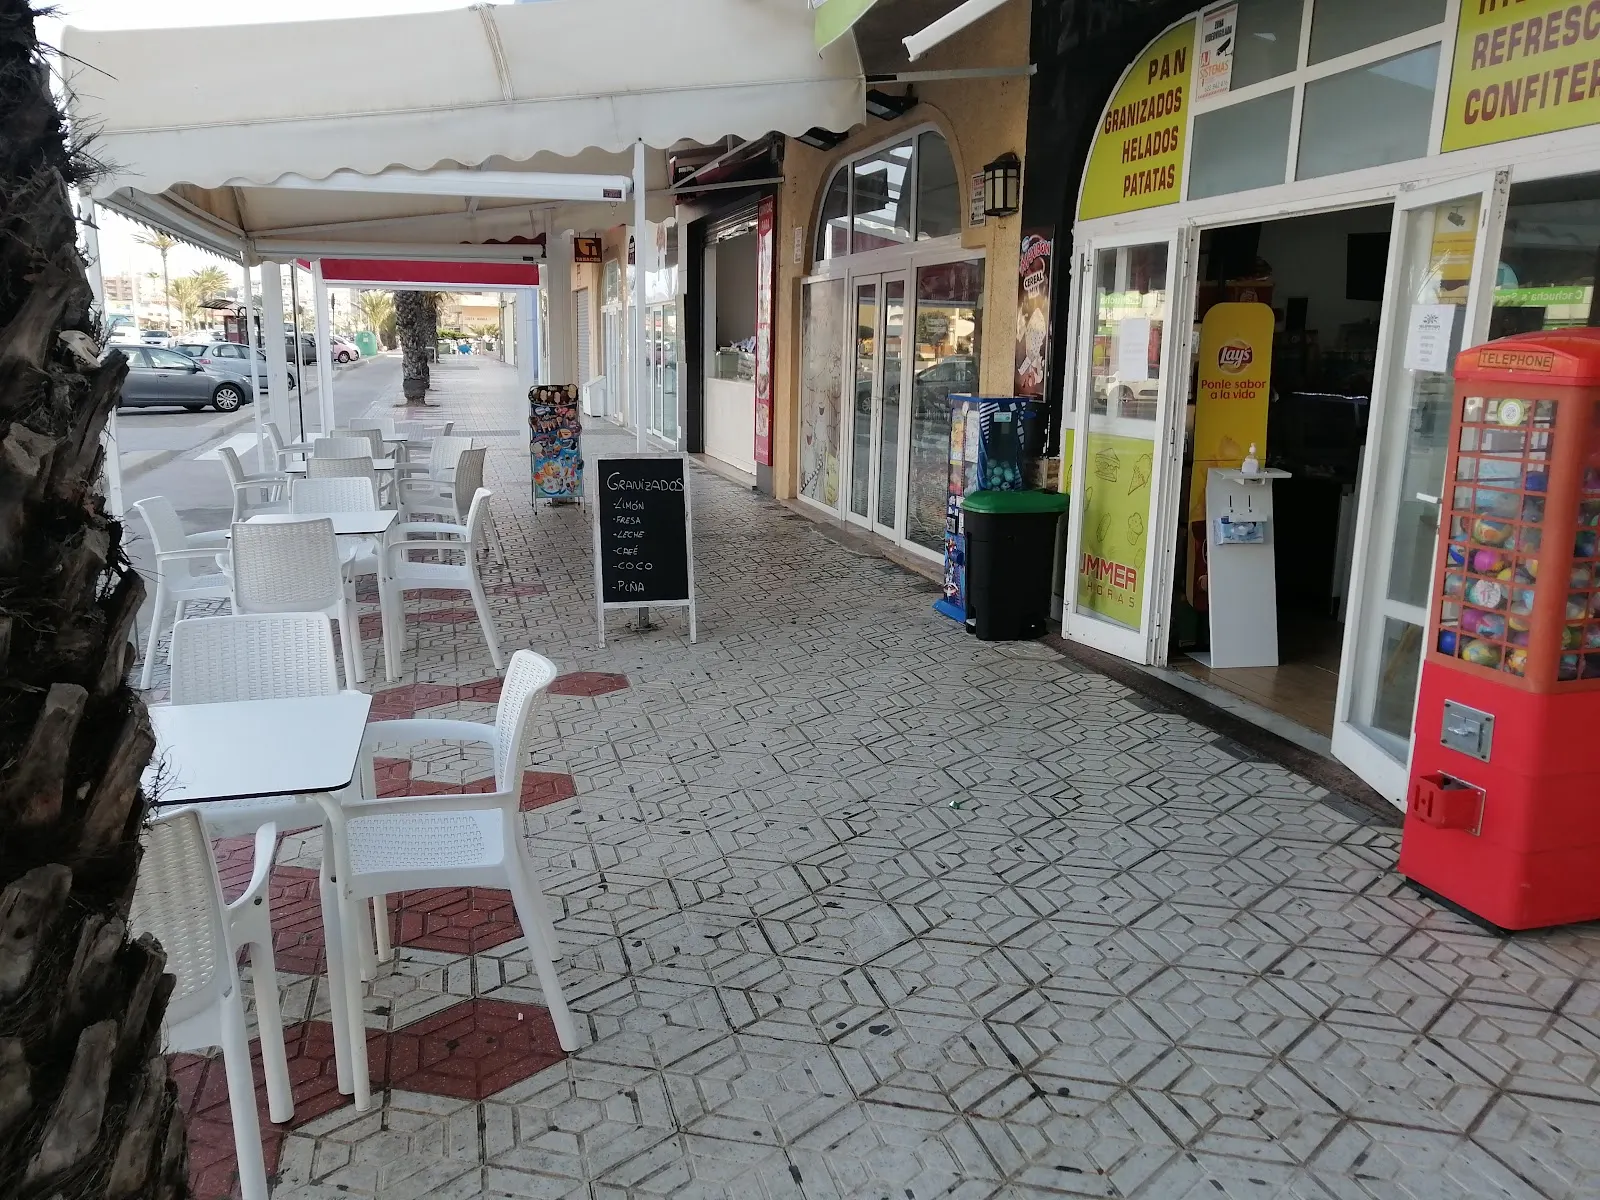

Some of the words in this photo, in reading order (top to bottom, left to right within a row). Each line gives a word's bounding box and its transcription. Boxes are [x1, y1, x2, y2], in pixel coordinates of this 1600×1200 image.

[1147, 46, 1187, 85] PAN
[1104, 86, 1183, 134] GRANIZADOS
[1122, 125, 1179, 164] HELADOS
[1123, 164, 1175, 198] PATATAS
[1024, 272, 1043, 288] CEREAL
[1219, 346, 1252, 368] Lay's
[1481, 352, 1552, 367] TELEPHONE
[1201, 379, 1232, 390] Ponle
[1235, 379, 1267, 389] sabor
[1210, 391, 1218, 400] a
[1220, 389, 1231, 400] la
[1233, 389, 1256, 399] vida
